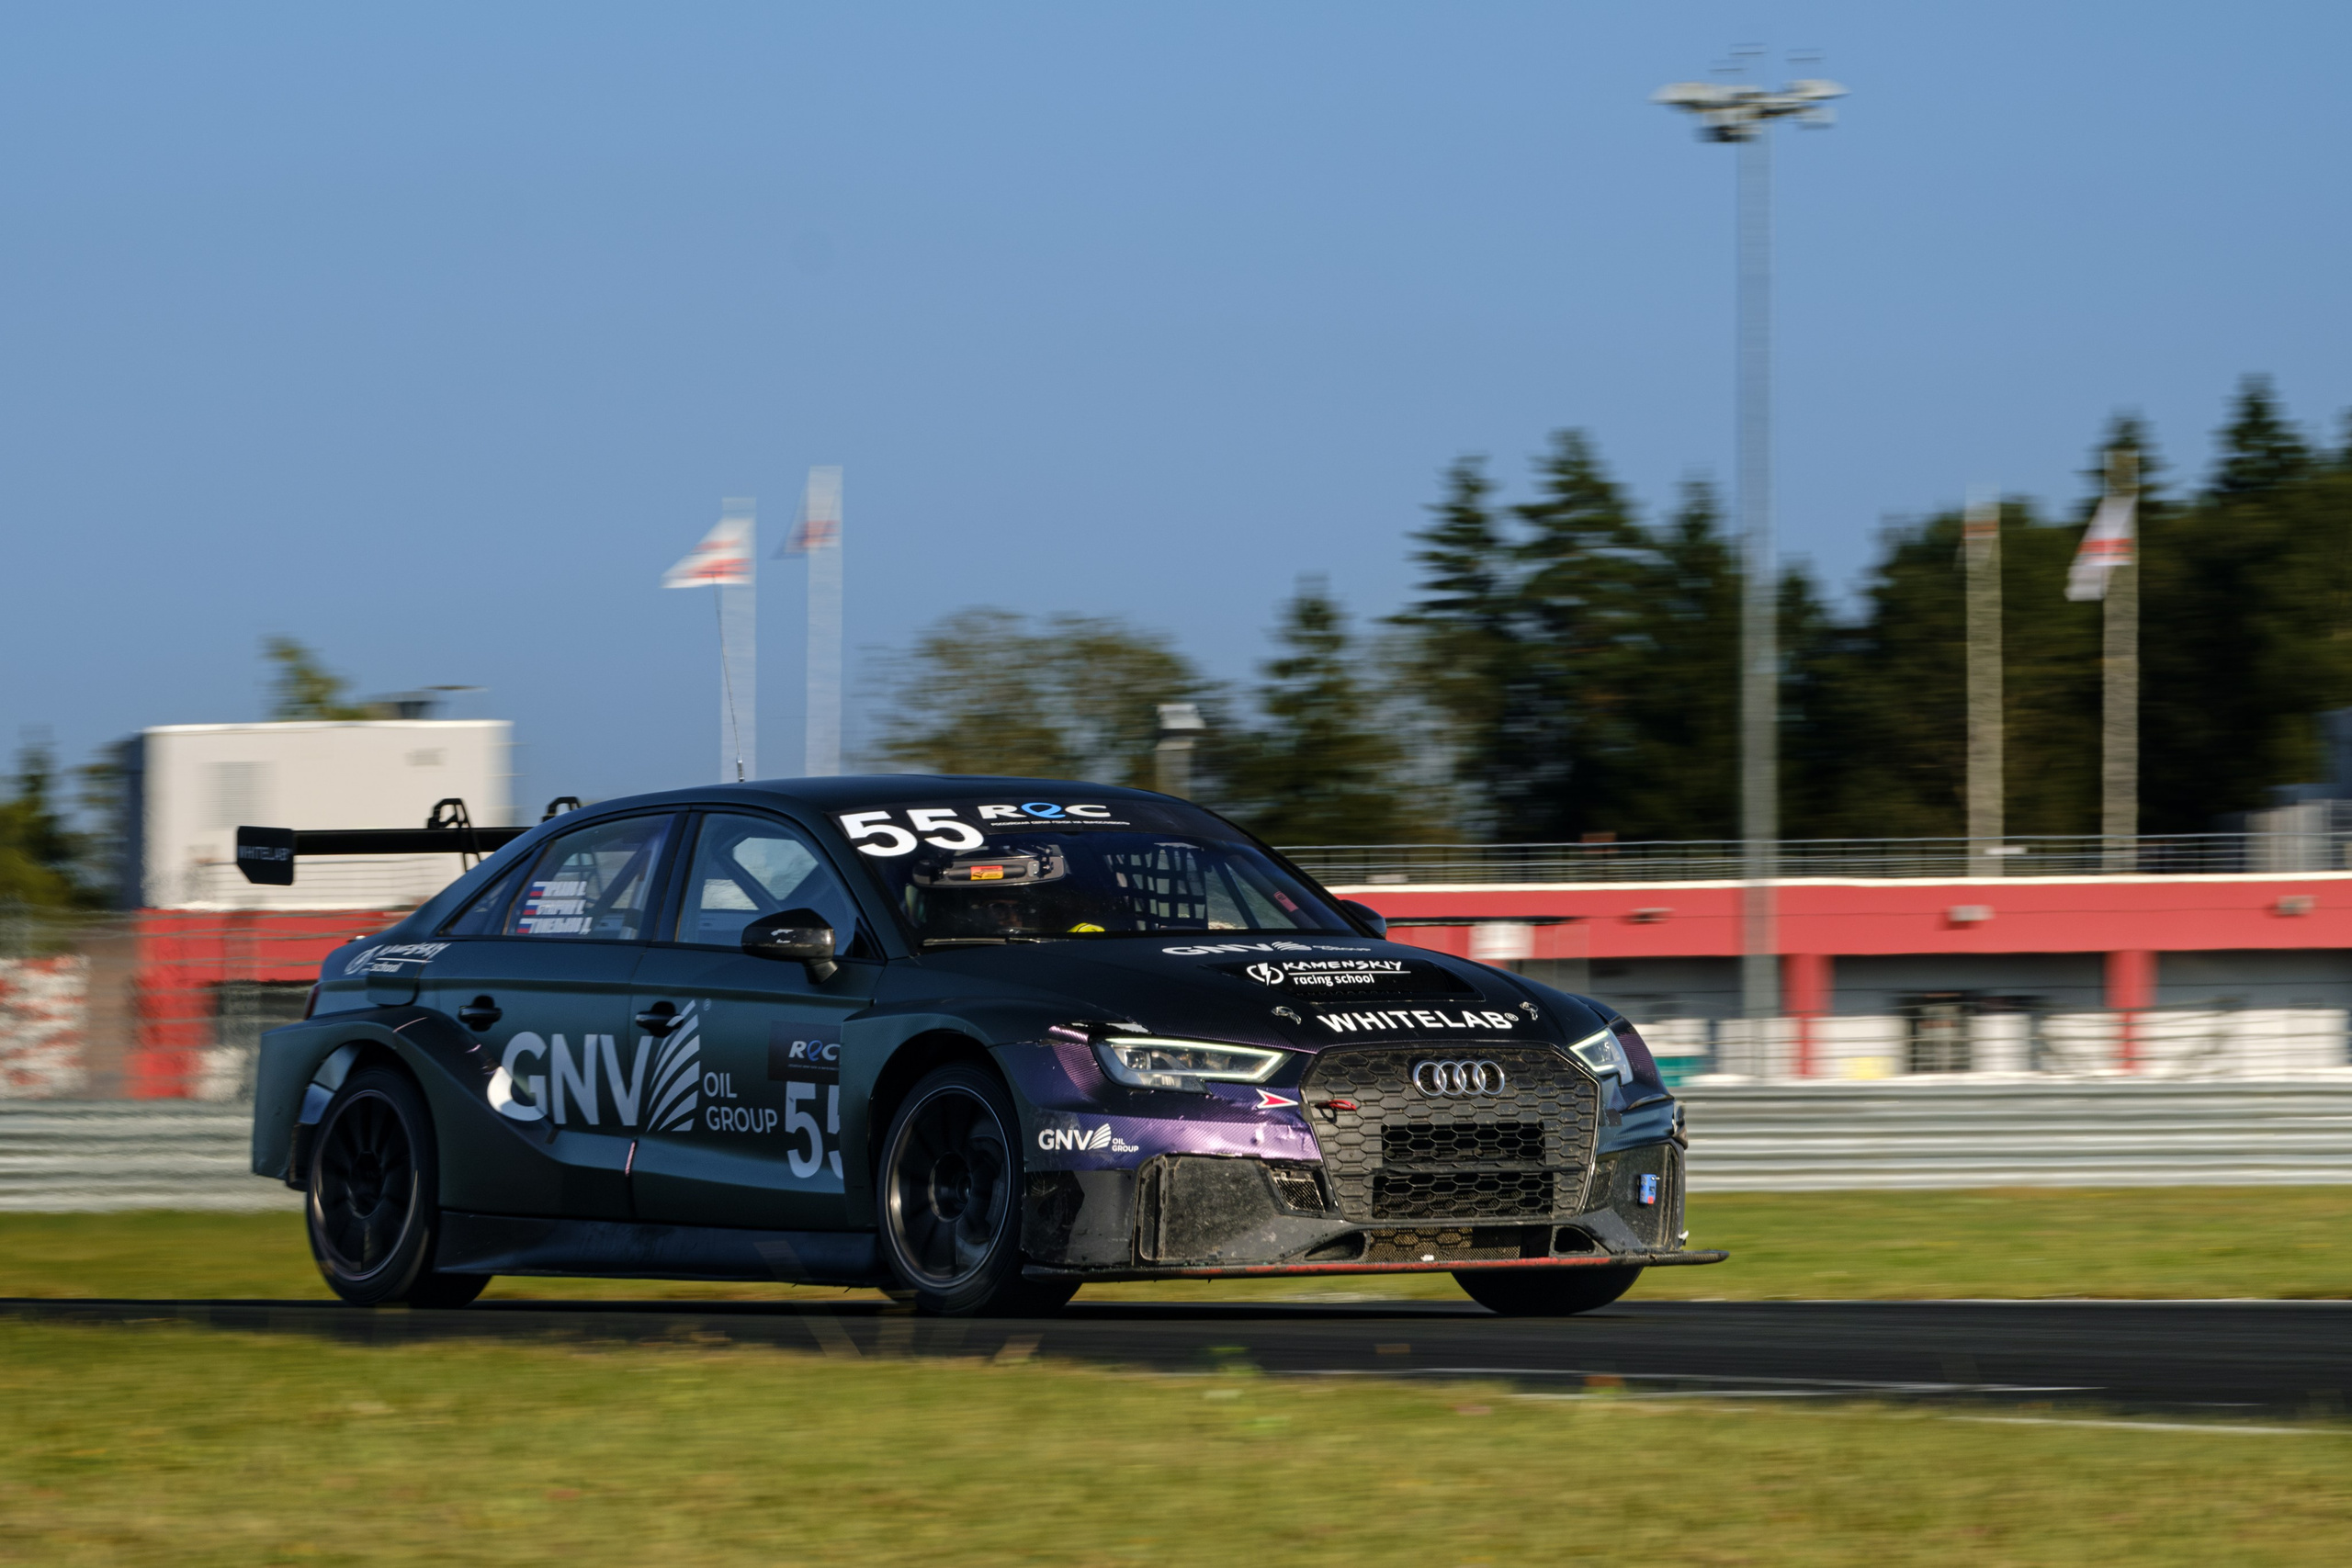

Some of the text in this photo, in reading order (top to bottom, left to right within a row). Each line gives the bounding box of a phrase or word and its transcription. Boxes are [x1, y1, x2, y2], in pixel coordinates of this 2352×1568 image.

[839, 808, 985, 857] 55
[1162, 943, 1274, 955] GNV
[1282, 960, 1402, 971] KAMENSKIY
[1293, 973, 1375, 987] racing school
[487, 1031, 653, 1126] GNV
[703, 1071, 738, 1099] OIL
[706, 1106, 778, 1134] GROUP
[1038, 1129, 1093, 1151] GNV
[1112, 1145, 1139, 1153] GROUP
